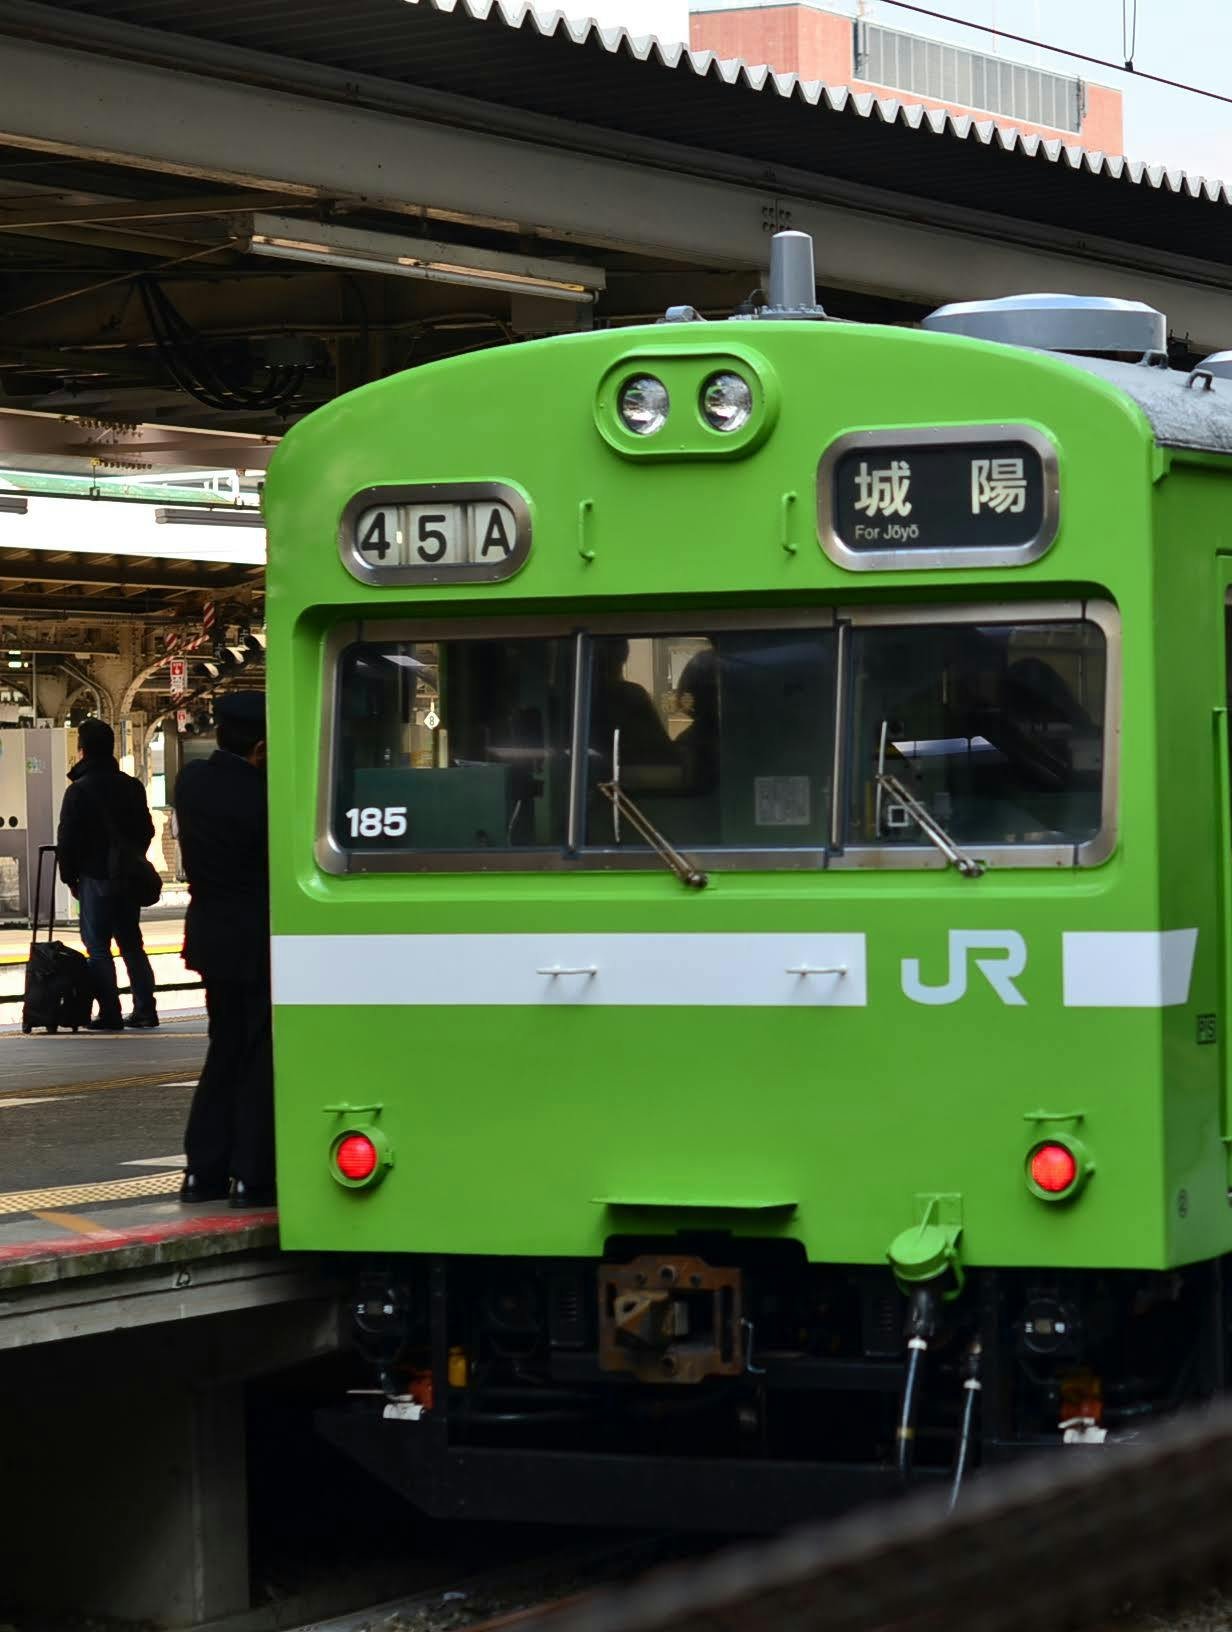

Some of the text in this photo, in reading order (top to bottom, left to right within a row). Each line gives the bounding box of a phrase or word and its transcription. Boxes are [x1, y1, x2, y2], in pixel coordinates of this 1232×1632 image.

[854, 459, 1027, 518] 城陽
[855, 525, 880, 540] For
[346, 806, 407, 838] 185
[901, 929, 1029, 1006] JR
